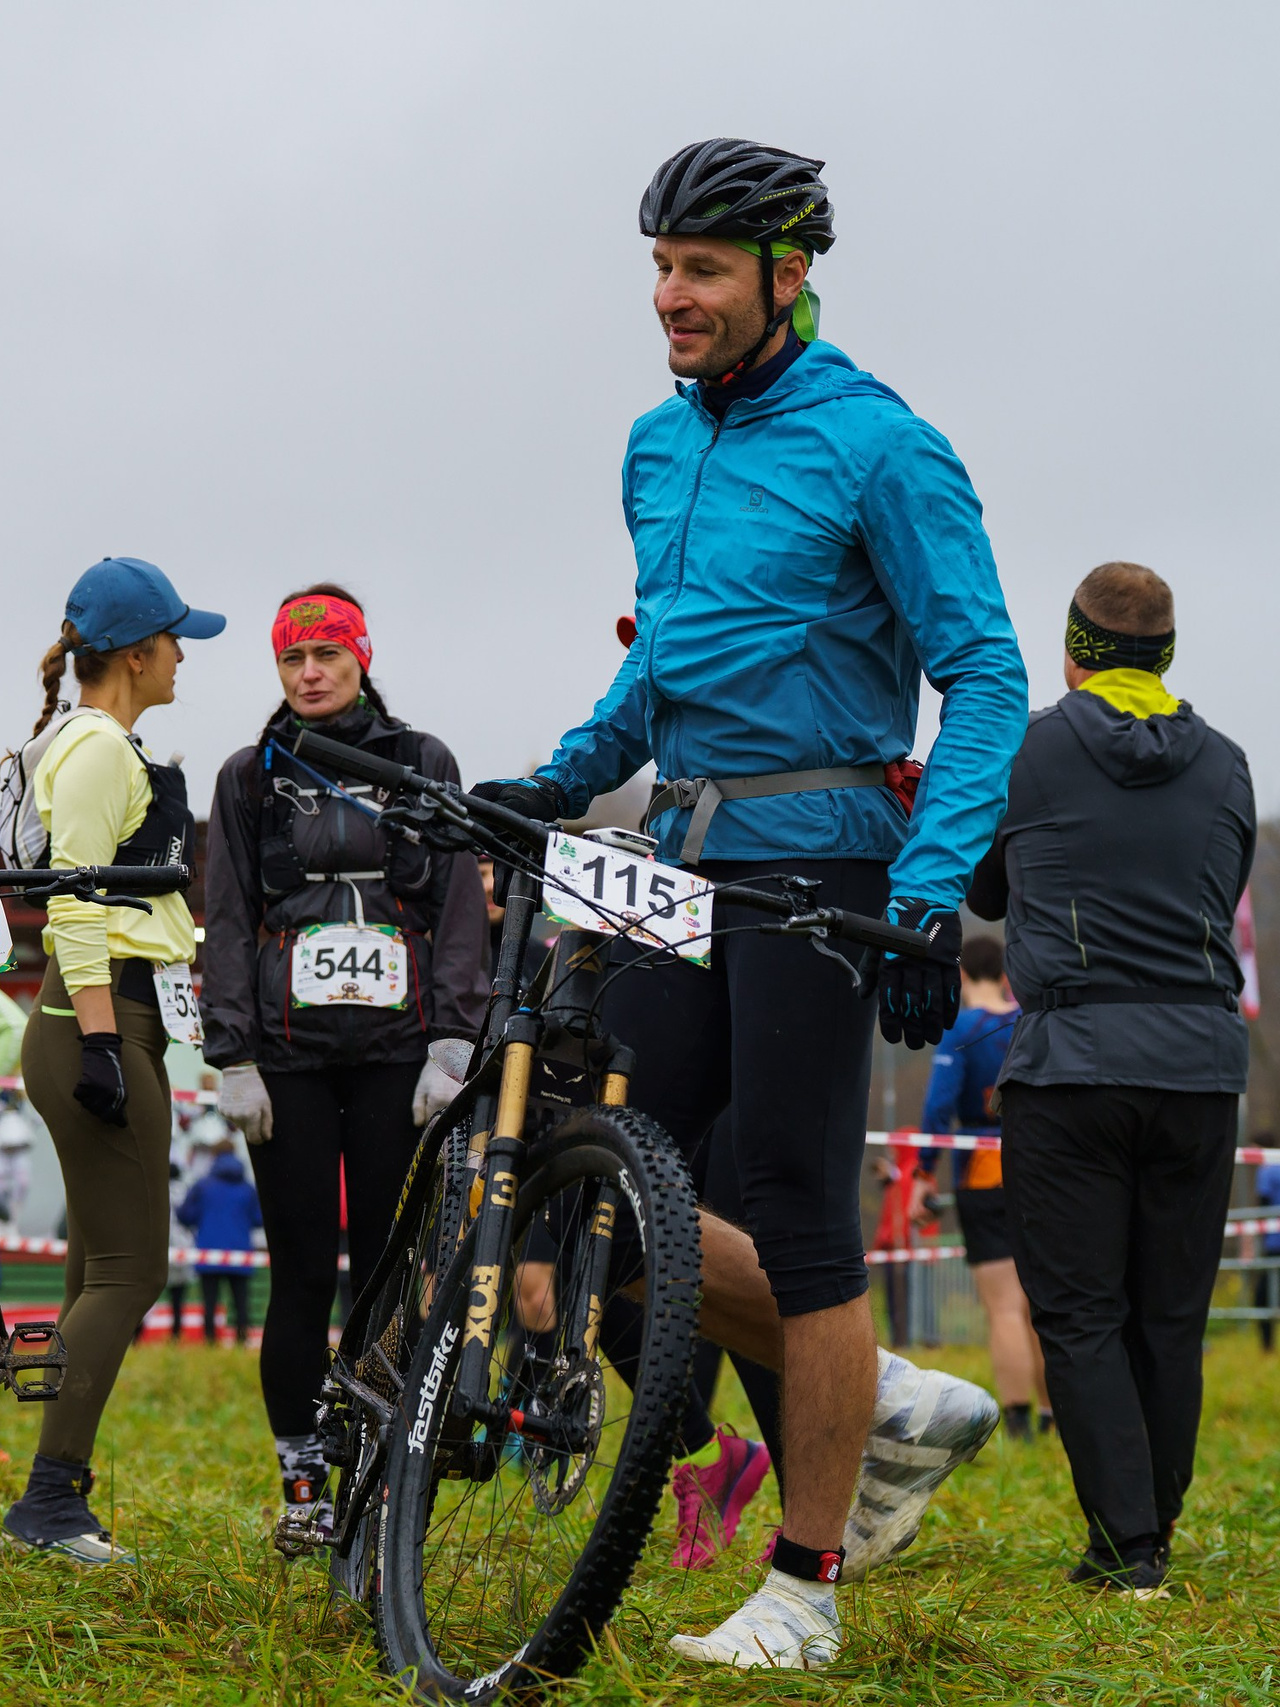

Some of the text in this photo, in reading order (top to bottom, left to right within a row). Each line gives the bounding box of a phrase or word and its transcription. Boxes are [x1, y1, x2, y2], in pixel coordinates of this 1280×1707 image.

[781, 201, 816, 232] KELLYS
[625, 834, 650, 846] GARMIN
[583, 855, 676, 919] 115
[314, 946, 384, 981] 544
[463, 1264, 501, 1348] FOX
